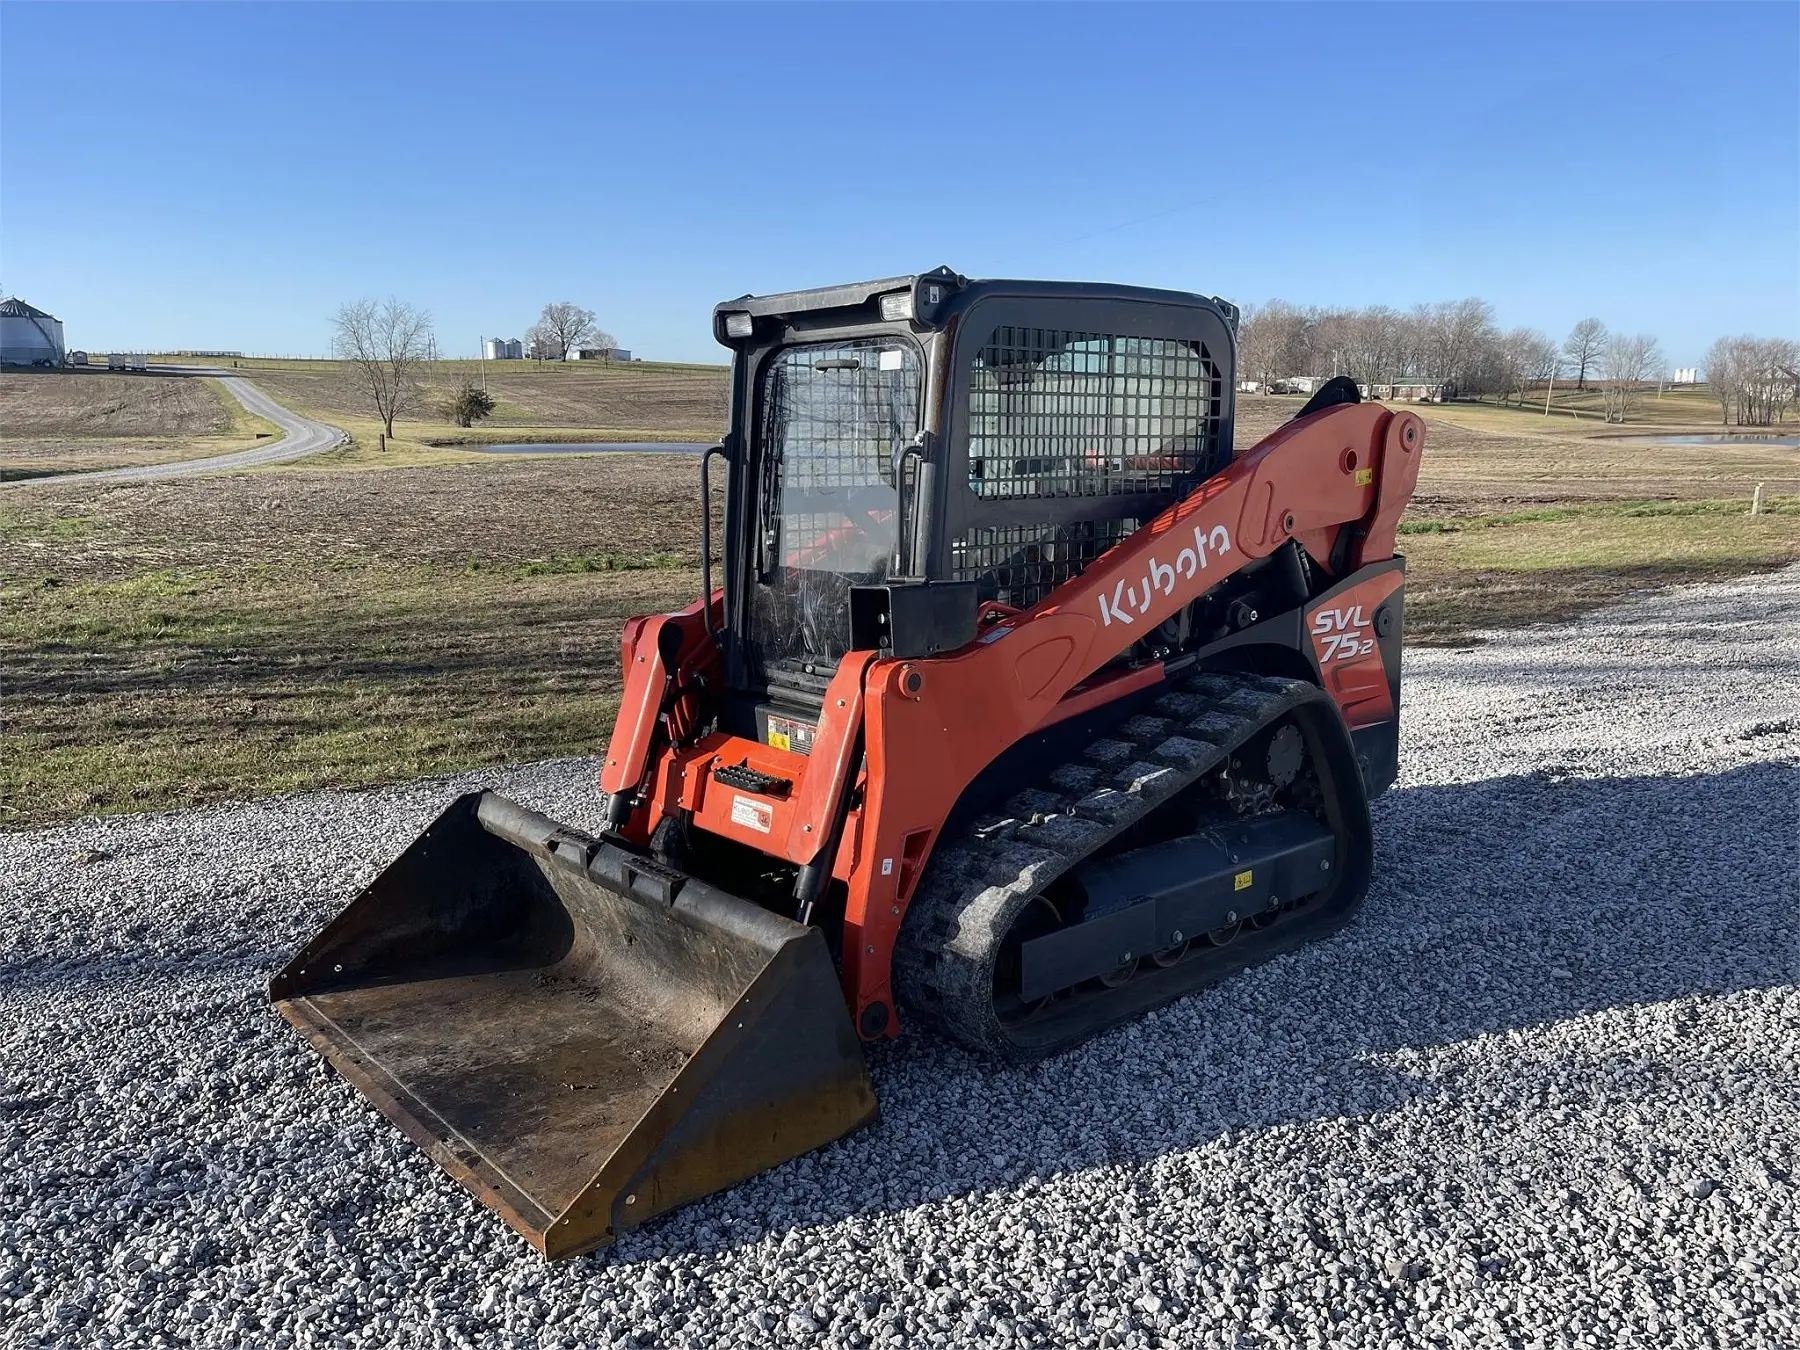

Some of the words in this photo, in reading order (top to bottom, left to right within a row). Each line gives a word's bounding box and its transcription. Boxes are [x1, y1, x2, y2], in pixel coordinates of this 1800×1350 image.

[1098, 525, 1231, 627] Kubota
[1311, 605, 1371, 635] SVL
[1320, 631, 1374, 664] 75-2
